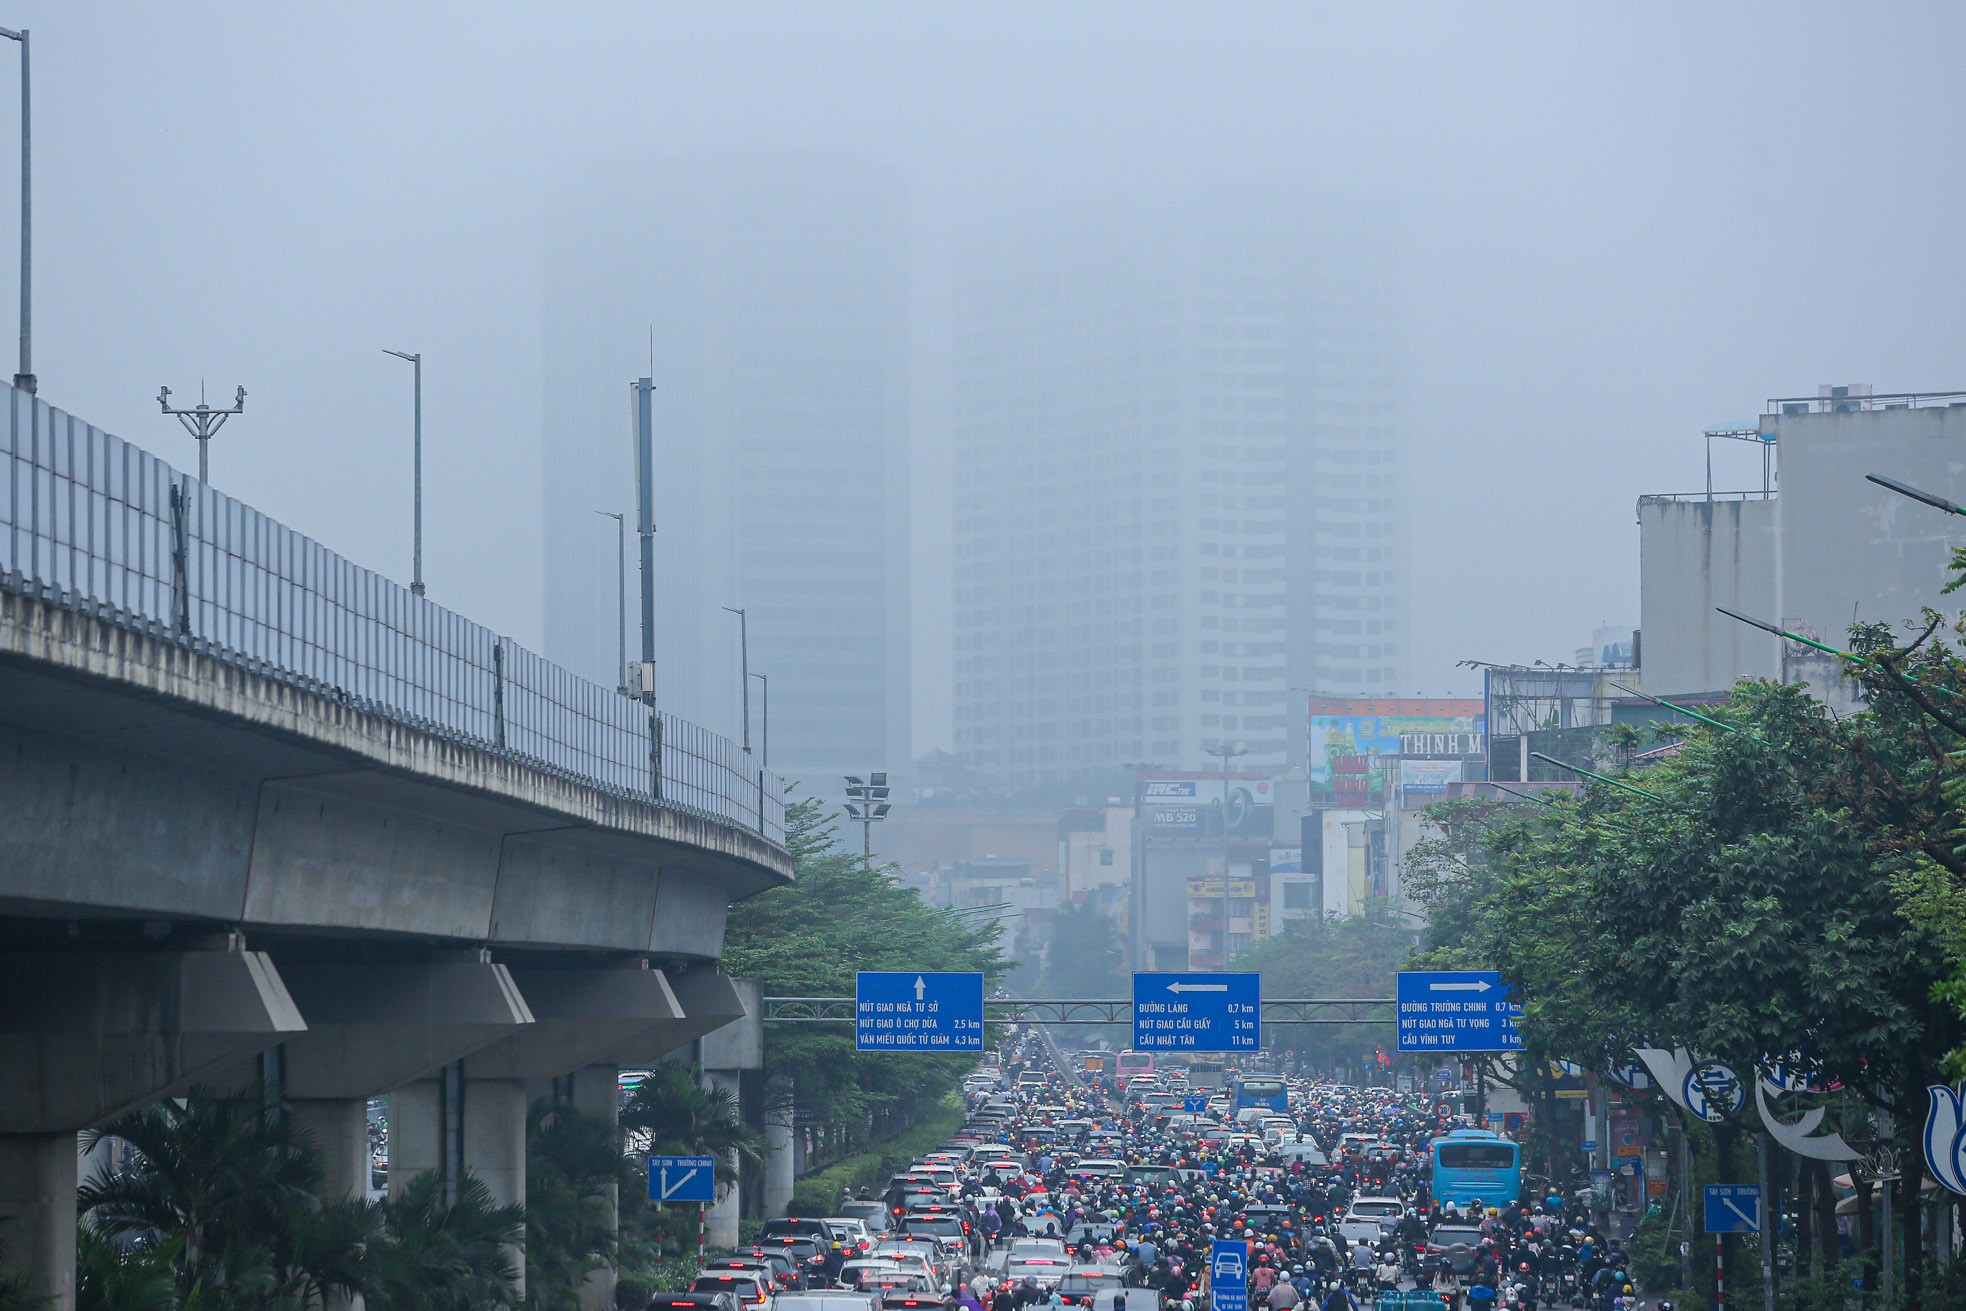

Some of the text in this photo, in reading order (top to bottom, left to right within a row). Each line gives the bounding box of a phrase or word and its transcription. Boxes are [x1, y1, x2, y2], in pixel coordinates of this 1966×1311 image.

[1176, 812, 1196, 822] 520
[859, 1000, 874, 1012] NÚT
[876, 1003, 894, 1012] GIAO
[896, 1001, 912, 1012] NGÃ
[1139, 1000, 1165, 1013] ĐƯỜNG
[1167, 1001, 1188, 1013] LÁNG
[1241, 1003, 1254, 1013] km
[1401, 1000, 1428, 1012] ĐƯỜNG
[1430, 1000, 1461, 1012] TRƯỜNG
[1463, 1003, 1487, 1012] CHINH
[859, 1016, 874, 1029] NÚT
[876, 1019, 893, 1028] GIAO
[904, 1019, 919, 1030] CHỢ
[968, 1019, 980, 1029] km
[1139, 1016, 1254, 1029] NÚT GIAO CẦU GIẤY 5 km
[1401, 1017, 1417, 1029] NÚT
[1419, 1019, 1436, 1029] GIAO
[1438, 1017, 1454, 1028] NGÃ
[1456, 1018, 1467, 1028] TƯ
[1469, 1018, 1490, 1030] VỌNG
[1501, 1019, 1507, 1028] 3
[860, 1033, 875, 1045] VĂN
[876, 1032, 895, 1045] MIẾU
[896, 1032, 917, 1045] QUỐC
[930, 1033, 950, 1045] GIÁM
[968, 1035, 980, 1045] km
[1139, 1033, 1254, 1047] CẦU NHẬT TÂN 11 km
[1402, 1033, 1417, 1045] CẦU
[1420, 1033, 1438, 1045] VĨNH
[1441, 1035, 1456, 1044] TUY
[1502, 1035, 1507, 1044] 8
